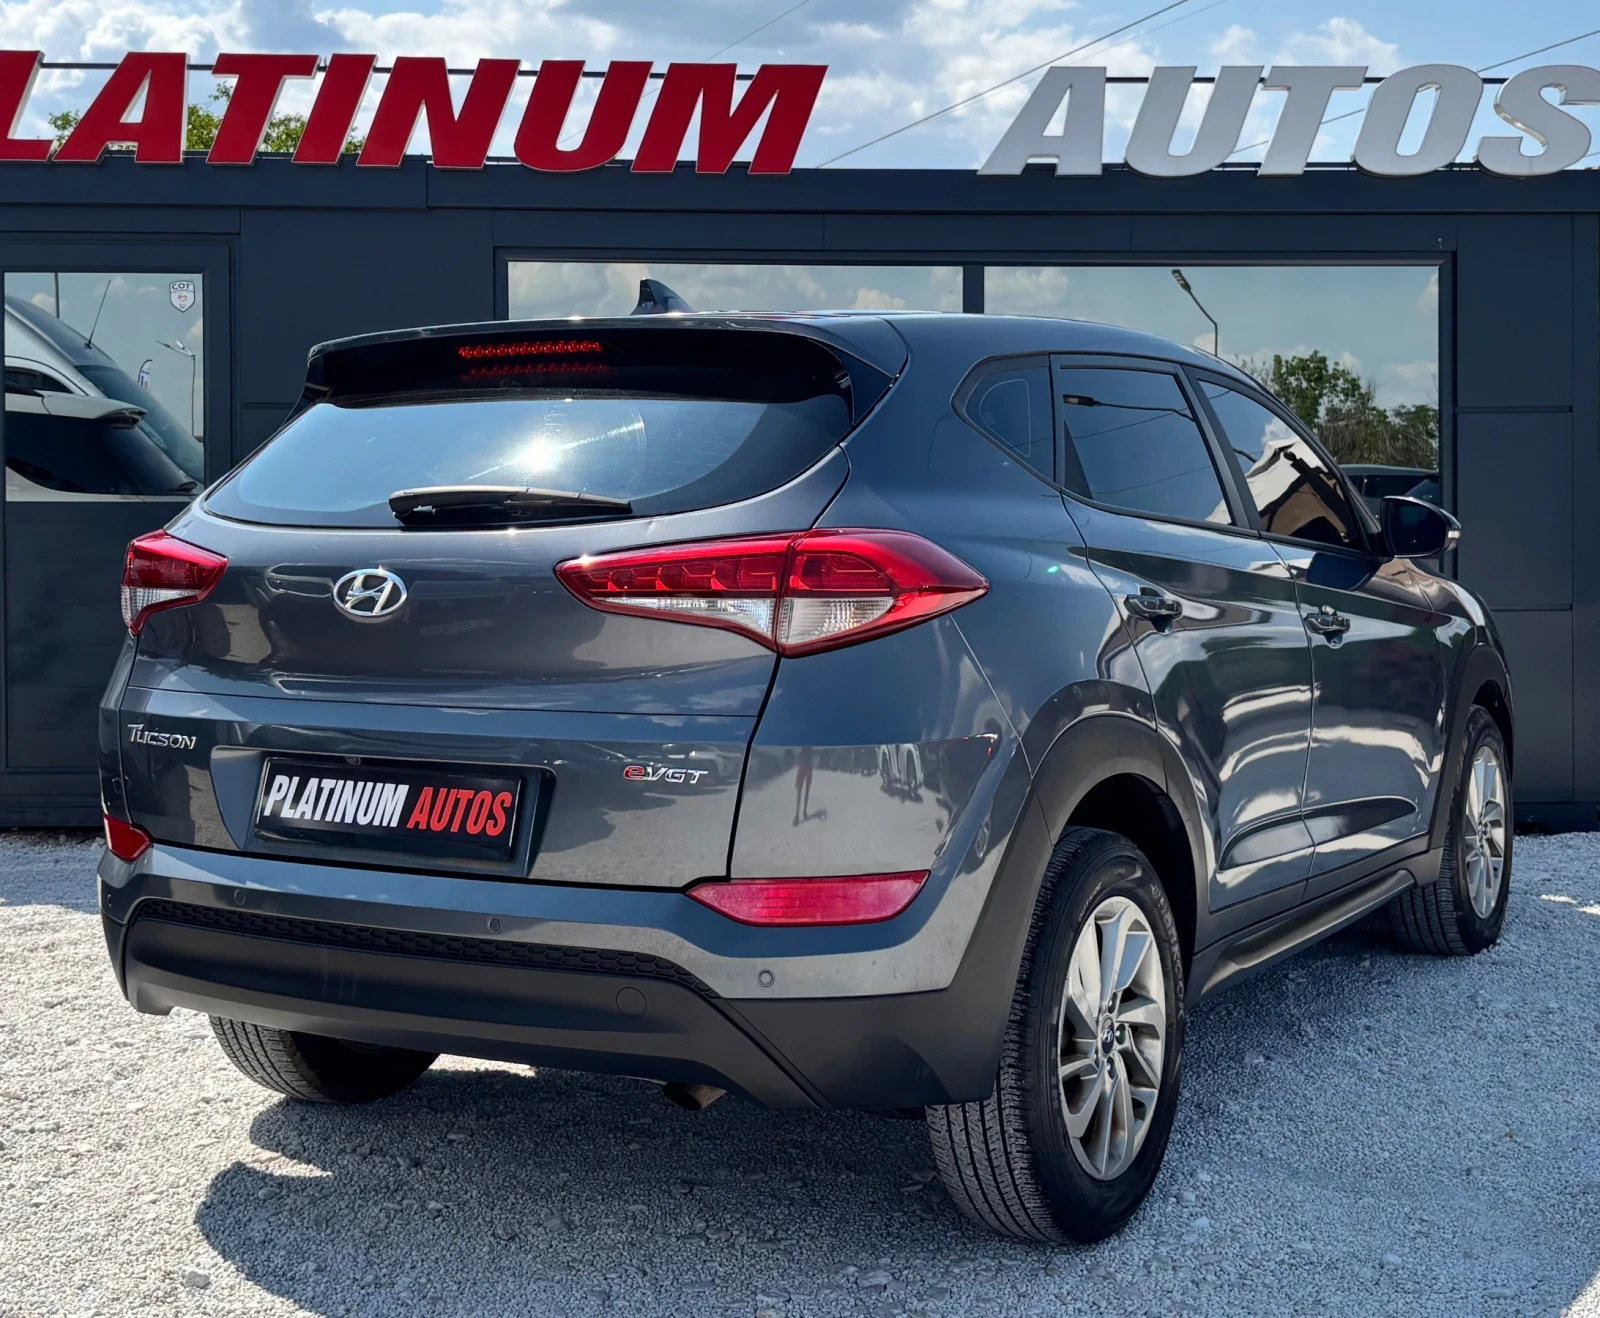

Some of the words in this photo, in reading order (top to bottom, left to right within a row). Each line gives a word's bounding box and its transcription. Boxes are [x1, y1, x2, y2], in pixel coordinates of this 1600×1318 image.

[976, 64, 1600, 179] AUTOS
[171, 282, 191, 290] COT
[623, 765, 709, 784] eVGT
[263, 774, 410, 828] PLATINUM
[406, 786, 513, 837] AUTOS
